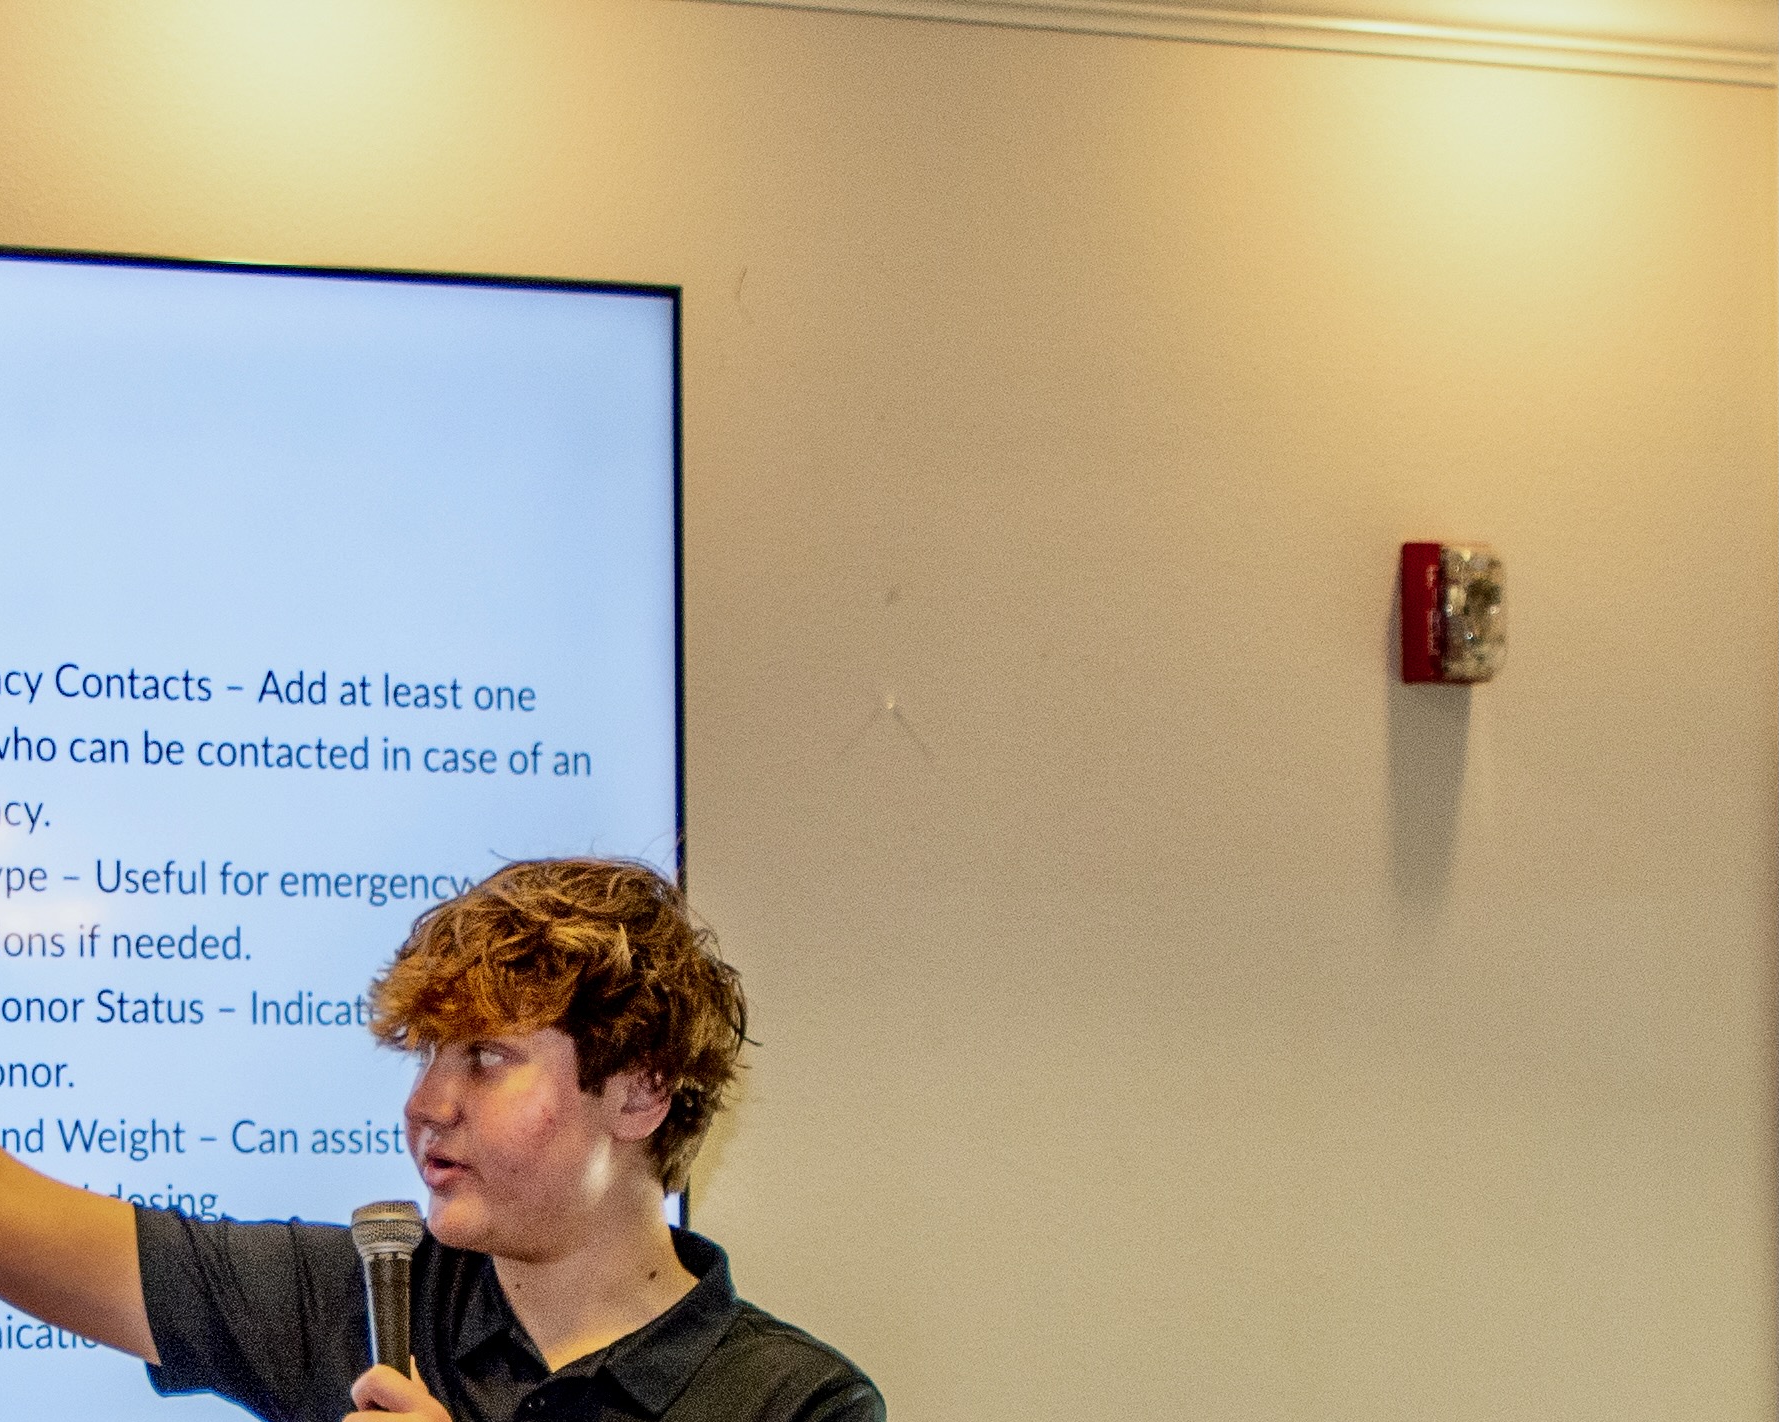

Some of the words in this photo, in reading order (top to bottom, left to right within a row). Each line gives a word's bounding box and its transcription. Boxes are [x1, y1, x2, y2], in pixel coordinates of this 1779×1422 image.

[55, 662, 212, 702] Contacts
[257, 669, 327, 705] Add
[339, 675, 372, 707] at
[384, 672, 462, 710] least
[474, 685, 536, 712] one
[69, 737, 129, 764] can
[143, 729, 185, 766] be
[197, 736, 369, 770] contacted
[383, 736, 411, 771] in
[423, 747, 497, 774] case
[508, 741, 542, 775] of
[553, 751, 591, 776] an
[96, 859, 206, 895] Useful
[220, 861, 269, 896] for
[80, 925, 100, 958] if
[113, 924, 251, 960] needed.
[96, 988, 204, 1025] Status
[57, 1118, 185, 1162] Weight
[231, 1119, 298, 1154] Can
[311, 1119, 404, 1154] assist
